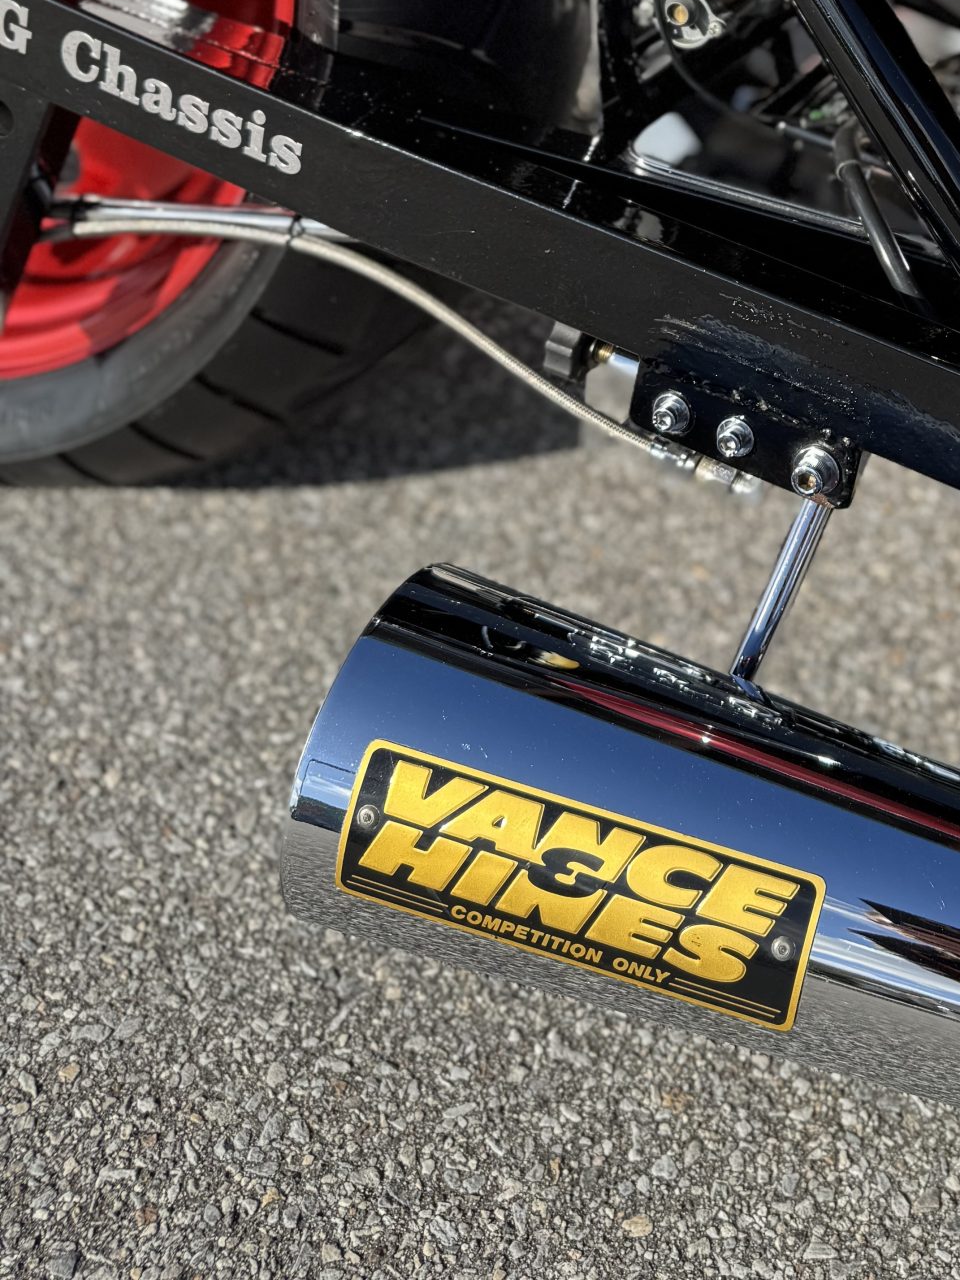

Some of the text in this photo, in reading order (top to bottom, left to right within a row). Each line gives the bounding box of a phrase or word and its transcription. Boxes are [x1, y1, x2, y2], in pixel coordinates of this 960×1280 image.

[61, 30, 303, 175] Chassis
[358, 822, 760, 984] HINES
[383, 758, 800, 936] VANCE
[450, 904, 671, 984] COMPETITION ONLY
